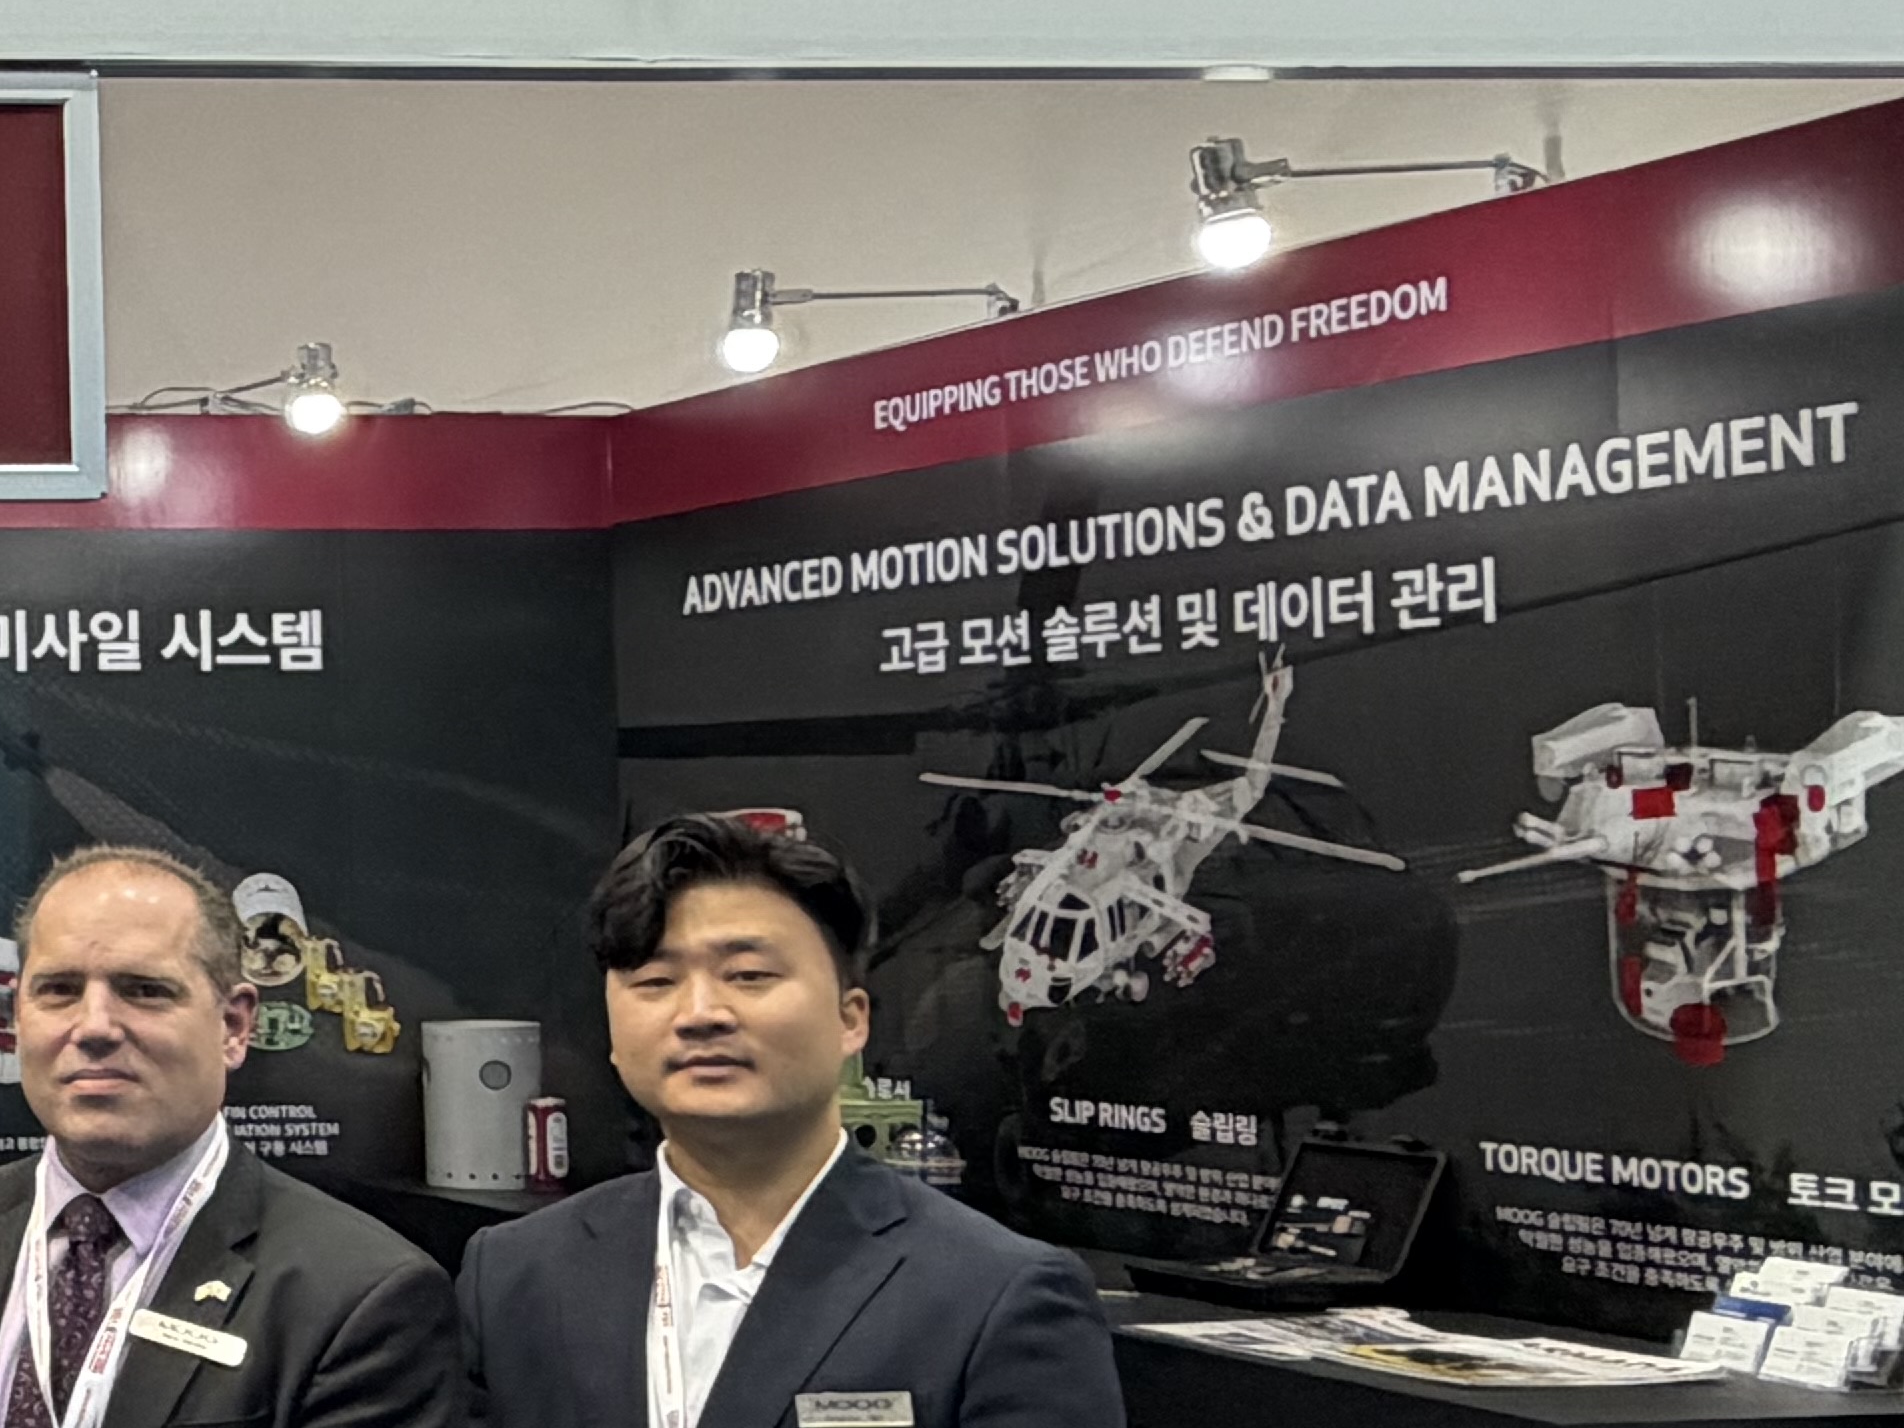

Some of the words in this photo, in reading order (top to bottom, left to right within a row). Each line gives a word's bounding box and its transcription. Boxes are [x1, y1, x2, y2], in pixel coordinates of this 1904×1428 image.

[873, 376, 1002, 432] EQUIPPING
[1004, 355, 1090, 400] THOSE
[1093, 340, 1162, 383] WHO
[1167, 314, 1284, 368] DEFEND
[1290, 276, 1449, 343] FREEDOM
[682, 555, 843, 616] ADVANCED
[850, 536, 990, 595] MOTION
[995, 495, 1226, 576] SOLUTIONS
[1237, 491, 1273, 541] &
[1285, 472, 1411, 536] DATA
[1423, 401, 1860, 514] MANAGEMENT
[879, 619, 951, 674] 고급
[958, 616, 1033, 668] 모션
[1040, 596, 1163, 658] 솔루션
[1177, 587, 1220, 647] 및
[1232, 567, 1377, 644] 데이터
[1390, 554, 1499, 628] 관리
[160, 608, 324, 672] 시스템
[249, 1105, 318, 1119] CONTROL
[285, 1122, 340, 1136] SYSTEM
[1049, 1096, 1095, 1126] SLIP
[1098, 1102, 1167, 1134] RINGS
[1190, 1110, 1258, 1146] 슬립링
[1480, 1141, 1604, 1184] TORQUE
[1611, 1154, 1751, 1199] MOTORS
[1787, 1172, 1860, 1211] 토크
